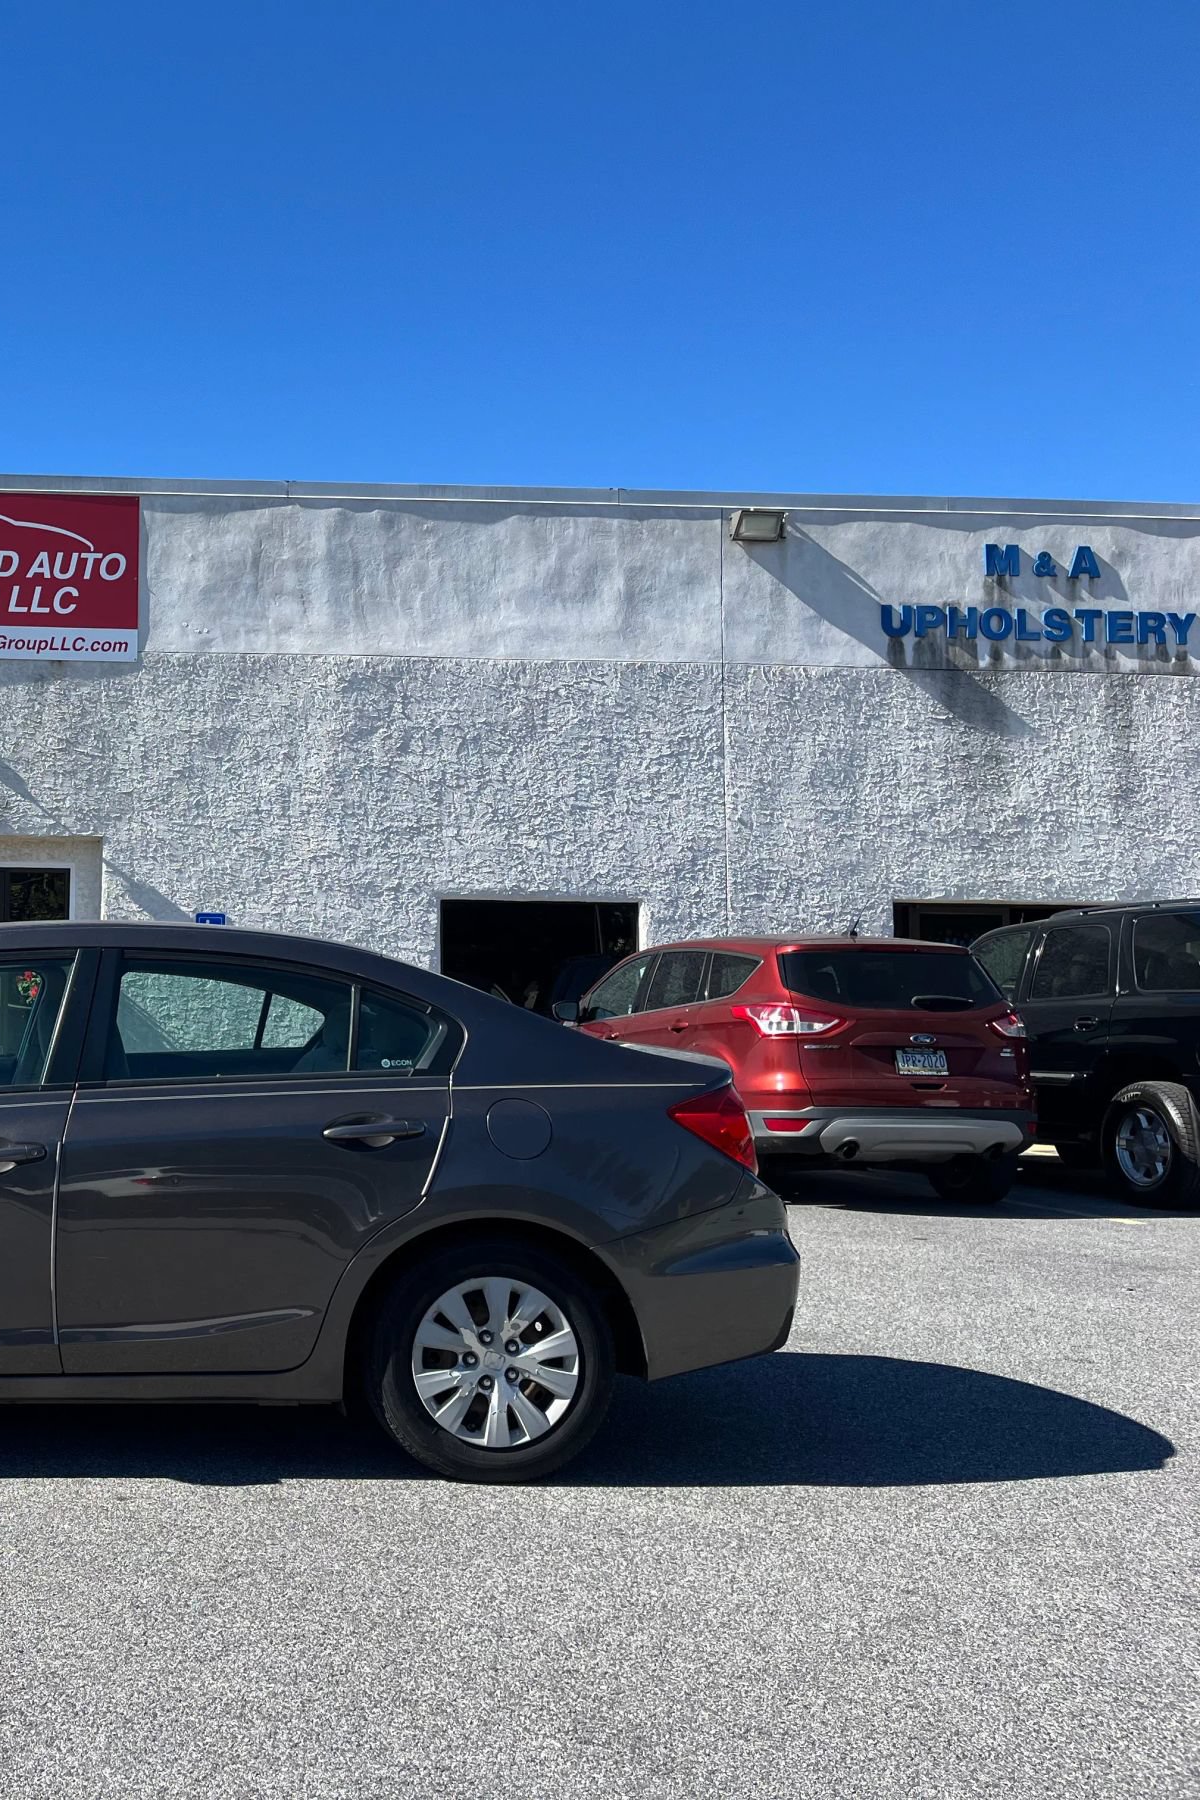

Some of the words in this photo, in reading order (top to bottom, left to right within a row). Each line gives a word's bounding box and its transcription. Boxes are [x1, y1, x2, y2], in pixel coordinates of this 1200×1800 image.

[25, 550, 127, 581] AUTO
[983, 543, 1020, 577] M
[1032, 551, 1058, 578] &
[1067, 545, 1101, 578] A
[7, 585, 80, 615] LLC
[880, 604, 1197, 646] UPHOLSTERY
